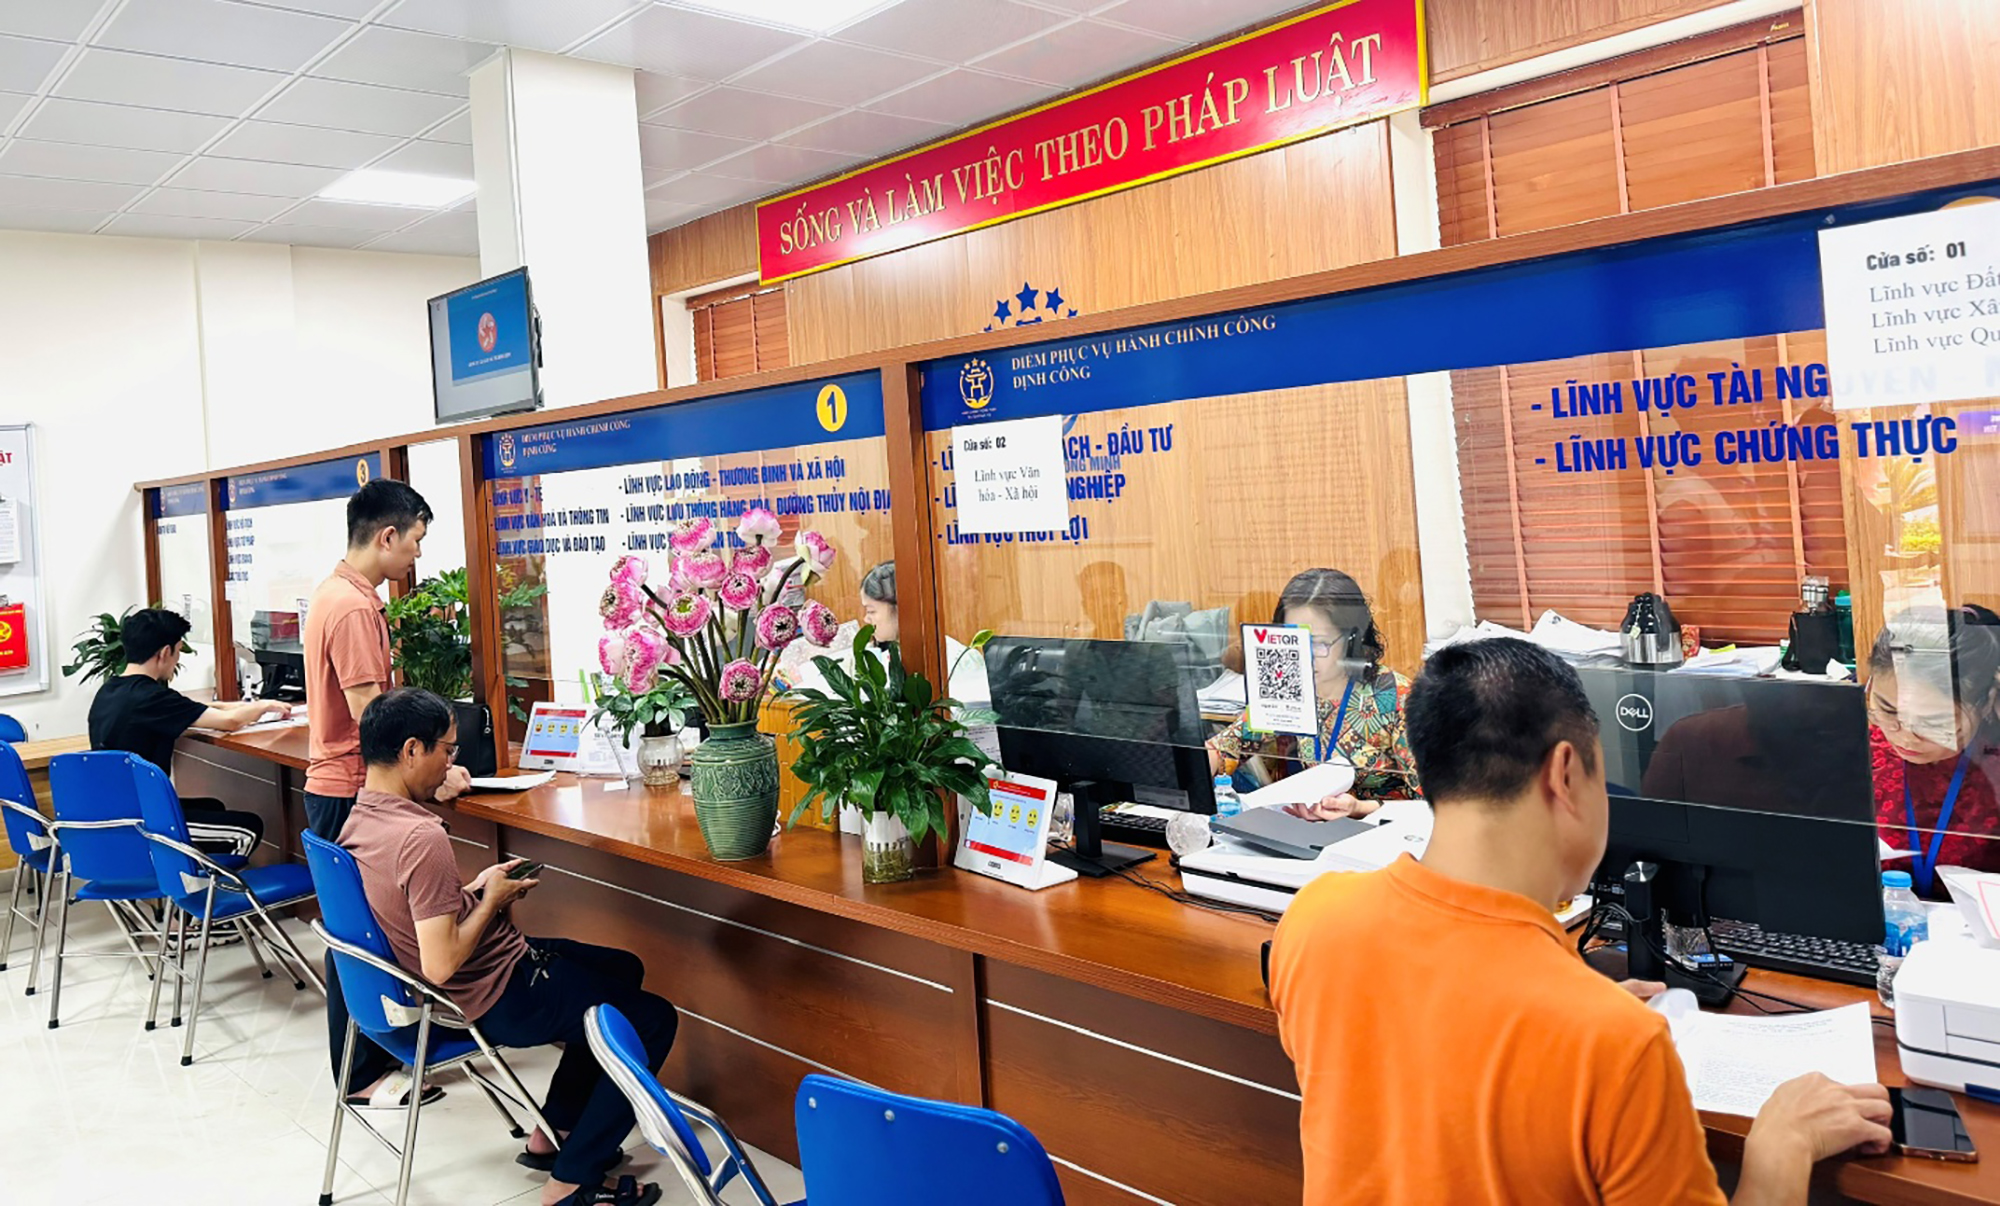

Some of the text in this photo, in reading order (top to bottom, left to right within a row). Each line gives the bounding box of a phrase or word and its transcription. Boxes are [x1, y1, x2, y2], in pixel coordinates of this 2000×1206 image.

[780, 32, 1382, 255] SỐNG VÀ LÀM VIỆC THEO PHÁP LUẬT
[1866, 251, 1900, 271] Cửa
[1946, 241, 1967, 259] 01
[1870, 283, 1914, 303] Lĩnh
[1922, 279, 1959, 296] vực
[1872, 299, 2000, 328] Lĩnh vực Xâ
[1050, 345, 1088, 364] PHỤC
[1091, 341, 1112, 359] VỤ
[1116, 334, 1160, 353] HÀNH
[1164, 323, 1219, 345] CHÍNH
[1223, 315, 1276, 336] CÔNG
[1874, 335, 1918, 354] Lĩnh
[1927, 333, 1963, 350] vực
[1049, 365, 1091, 384] CÔNG
[1552, 379, 1623, 418] LĨNH
[1632, 373, 1697, 417] VỰC
[1707, 362, 1763, 405] TÀI
[941, 445, 954, 470] LĨ
[1107, 422, 1144, 456] ĐẦU
[1149, 424, 1173, 452] TƯ
[996, 436, 1007, 448] 02
[1555, 434, 1627, 472] LĨNH
[1635, 431, 1701, 475] VỰC
[1714, 420, 1839, 465] CHỨNG
[1851, 415, 1957, 468] THỰC
[624, 474, 644, 494] LĨNH
[645, 474, 662, 496] VỰC
[664, 473, 682, 491] LAO
[684, 468, 710, 493] ĐỘNG
[718, 466, 759, 486] THƯƠNG
[761, 464, 787, 484] BINH
[789, 458, 804, 481] VÀ
[807, 456, 823, 480] XÃ
[825, 455, 845, 482] HỘI
[975, 468, 996, 482] Lĩnh
[1019, 466, 1040, 479] Văn
[596, 508, 609, 524] TIN
[626, 503, 645, 522] LĨNH
[647, 503, 664, 525] VỰC
[685, 498, 717, 519] THÔNG
[816, 486, 845, 513] THỦY
[849, 486, 870, 515] NỘI
[628, 531, 647, 550] LĨNH
[649, 533, 666, 553] VỰC
[1620, 706, 1649, 719] DELL
